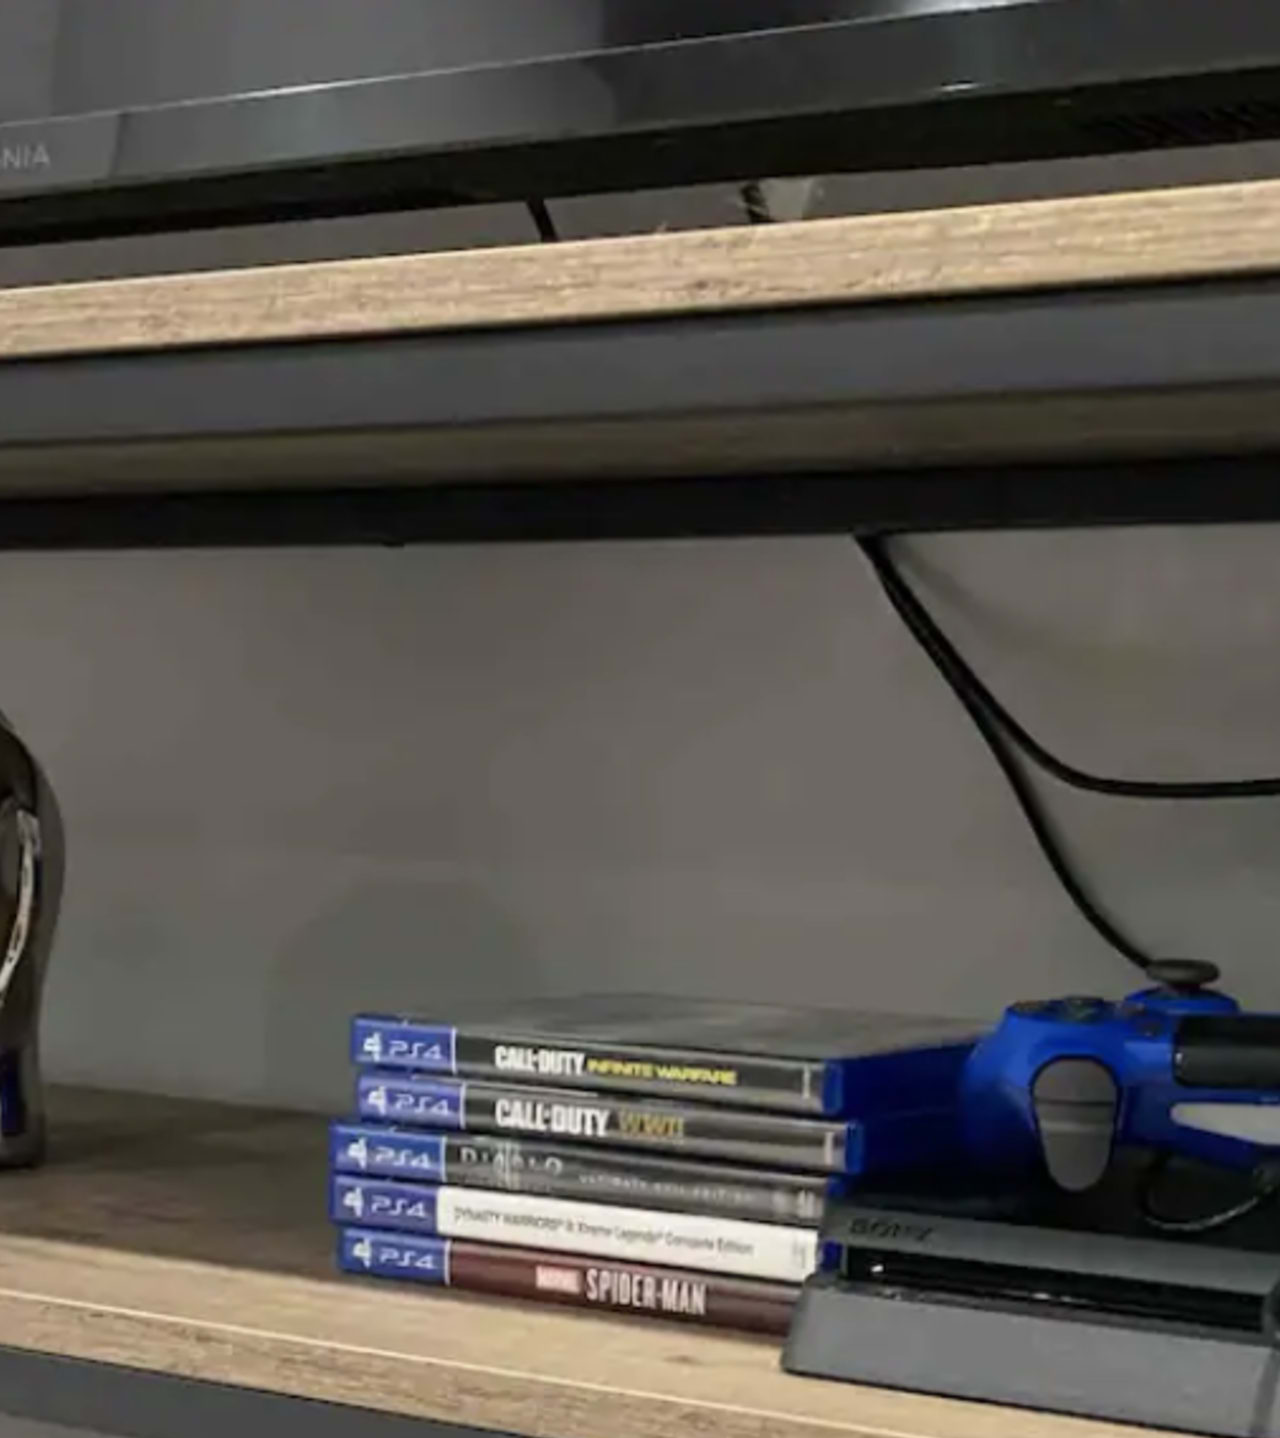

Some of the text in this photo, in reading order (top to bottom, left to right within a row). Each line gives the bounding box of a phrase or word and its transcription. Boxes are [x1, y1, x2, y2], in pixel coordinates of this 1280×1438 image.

[388, 1040, 443, 1061] PS4
[494, 1045, 738, 1086] CALL DUTY INFINITE WARFARE
[394, 1093, 450, 1117] PS4
[494, 1098, 547, 1132] CALL
[550, 1104, 610, 1137] DUTY
[375, 1147, 432, 1169] PS4
[371, 1195, 428, 1218] PS4
[380, 1249, 437, 1270] PS4
[585, 1267, 707, 1316] SPIDER-MAN
